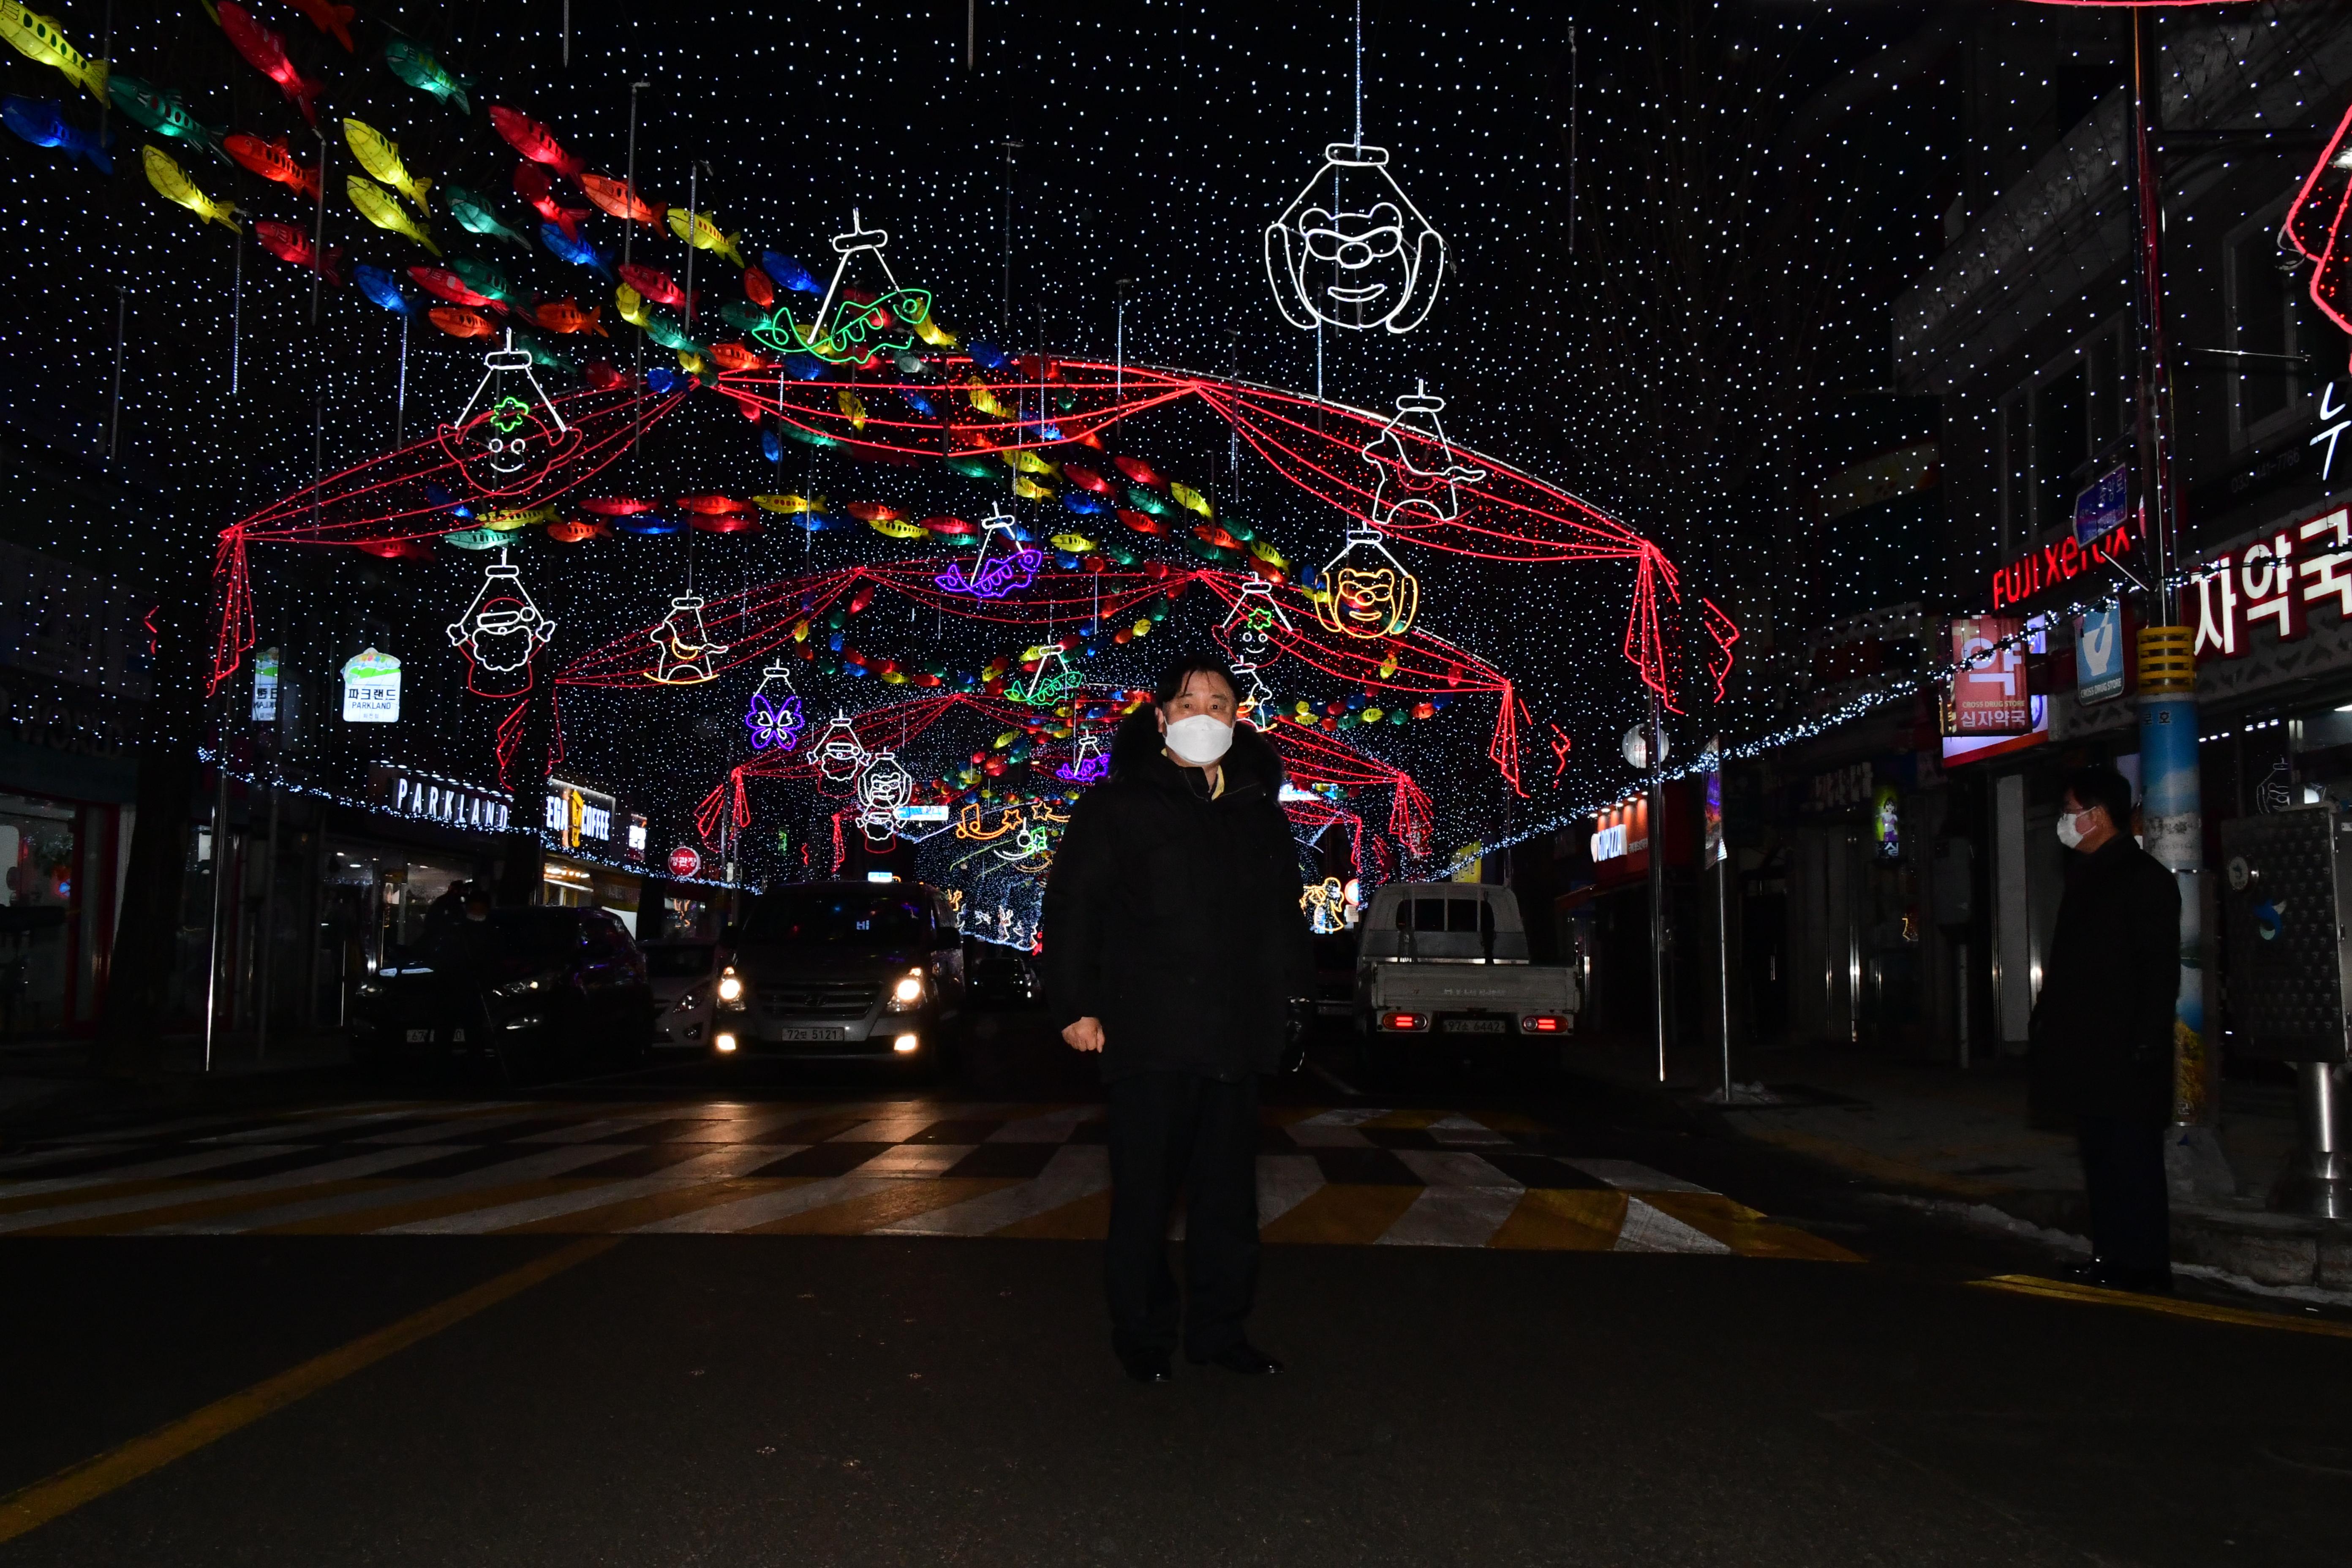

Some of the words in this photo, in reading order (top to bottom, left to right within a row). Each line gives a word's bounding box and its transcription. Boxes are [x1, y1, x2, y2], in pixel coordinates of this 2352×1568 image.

[2099, 473, 2124, 507] 중앙로
[1993, 554, 2038, 610] FUJI
[2191, 508, 2352, 656] 자약국
[1961, 635, 2022, 696] 약
[348, 689, 395, 700] 파크랜드
[1960, 710, 2025, 727] 십자약국
[397, 778, 508, 830] PARKLAND
[546, 795, 569, 830] EGA
[581, 804, 610, 841] COFFEE
[670, 857, 697, 866] 정관장
[812, 1029, 836, 1040] 5121
[1474, 1021, 1500, 1031] 6442
